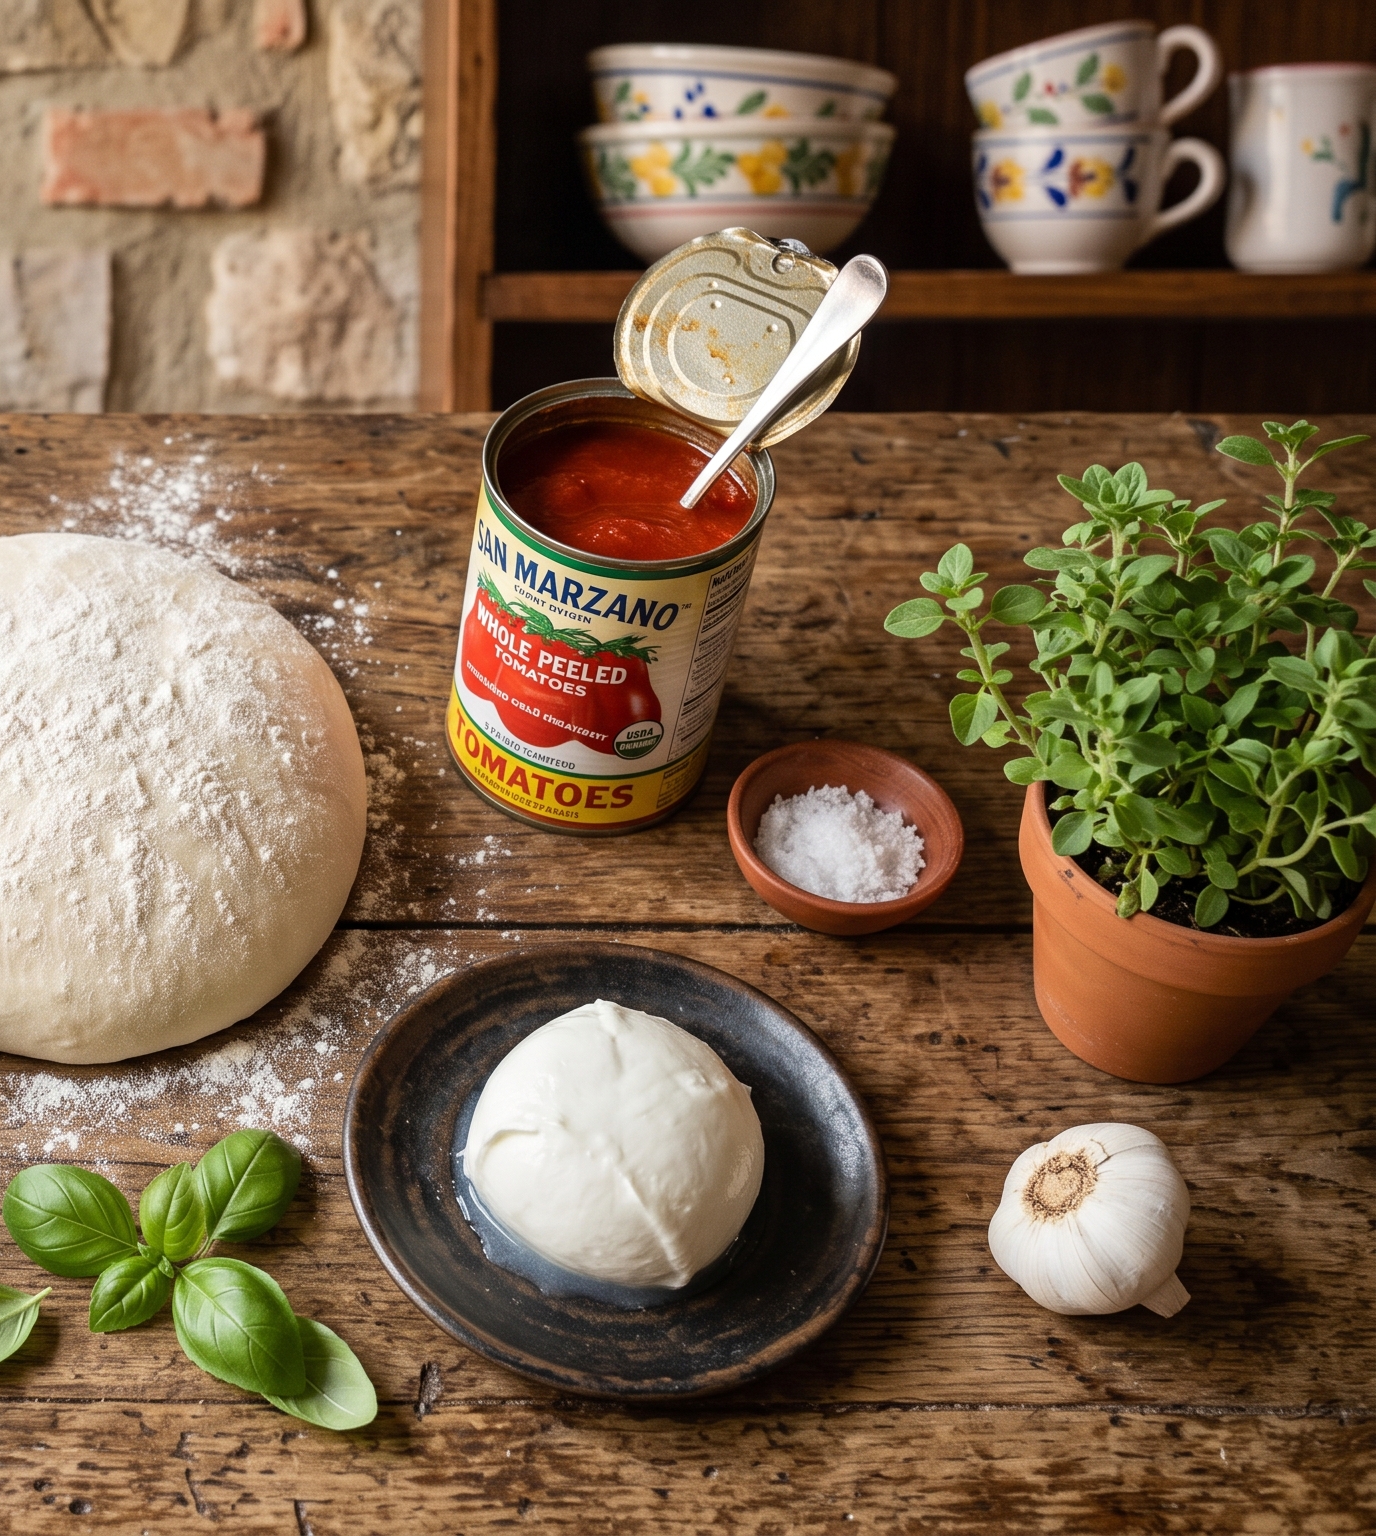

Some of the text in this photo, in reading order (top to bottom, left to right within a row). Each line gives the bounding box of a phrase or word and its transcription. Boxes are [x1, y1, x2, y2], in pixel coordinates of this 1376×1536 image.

[477, 518, 507, 573] SAN
[514, 551, 679, 631] MARZANO
[477, 599, 532, 662] WHOLE
[537, 649, 628, 685] PEELED
[494, 644, 587, 697] TOMATOES
[456, 707, 634, 810] TOMATOES
